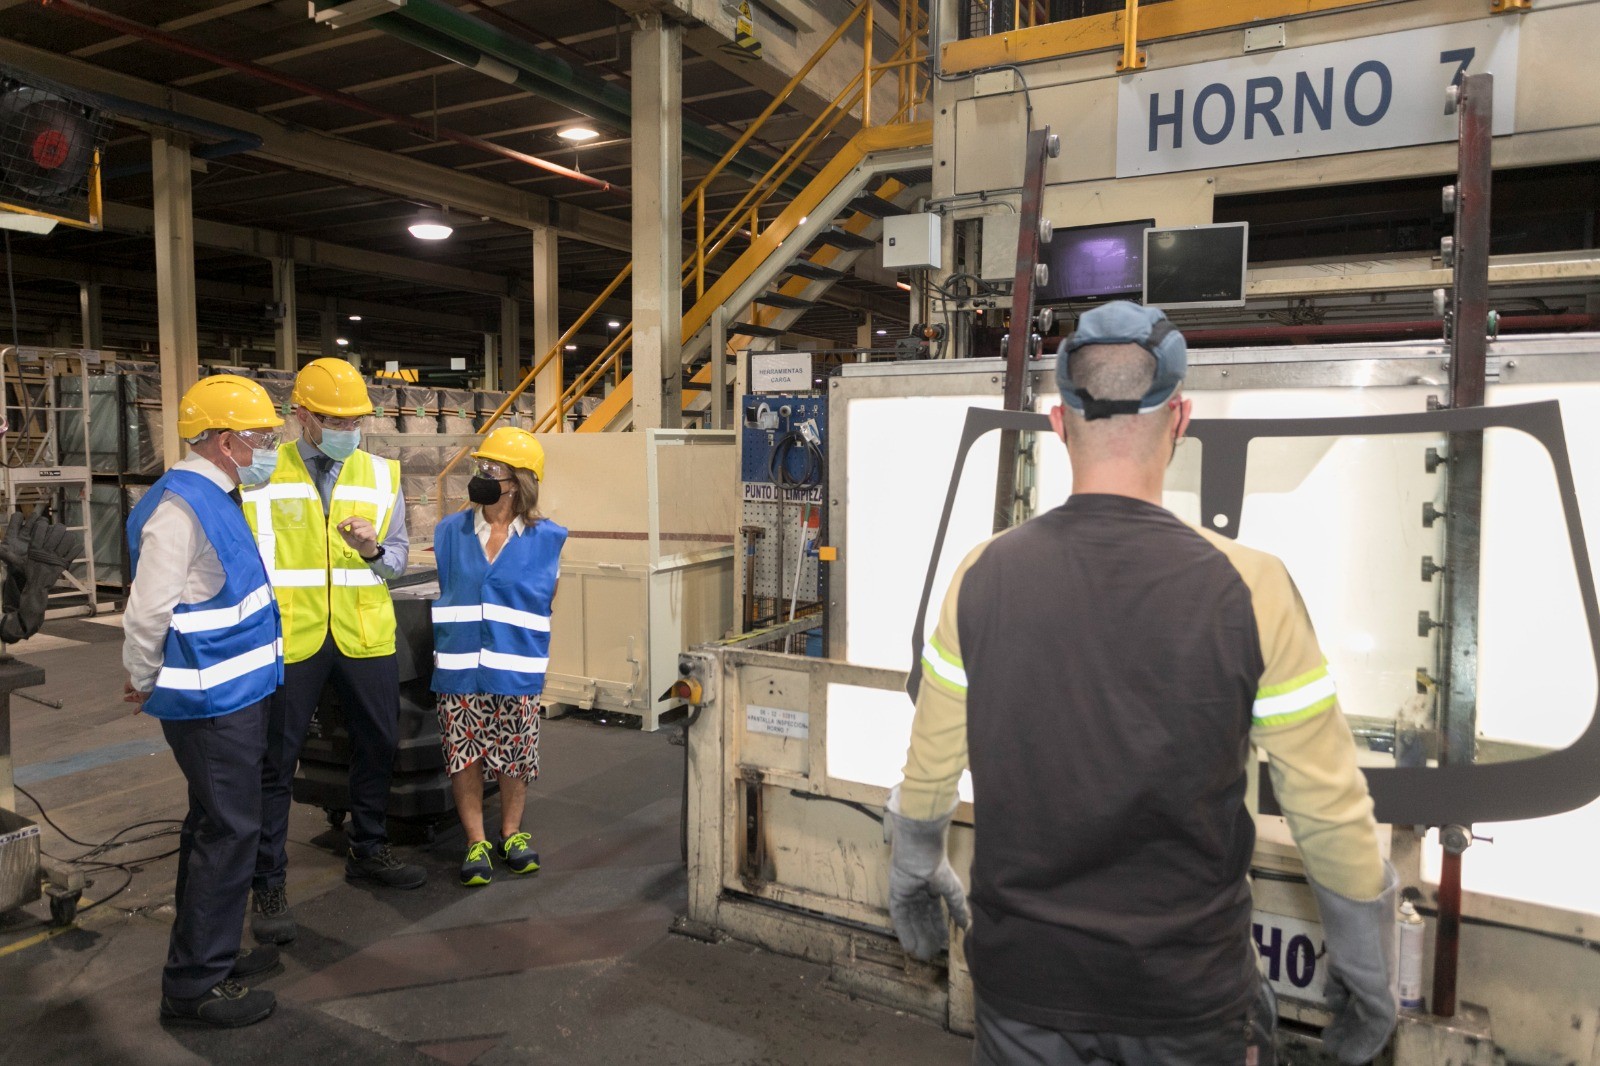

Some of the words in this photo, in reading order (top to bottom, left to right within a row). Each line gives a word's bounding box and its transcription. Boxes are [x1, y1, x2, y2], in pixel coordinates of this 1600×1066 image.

[1149, 60, 1393, 152] HORNO
[1440, 47, 1476, 116] 7
[745, 485, 772, 499] PUNTO
